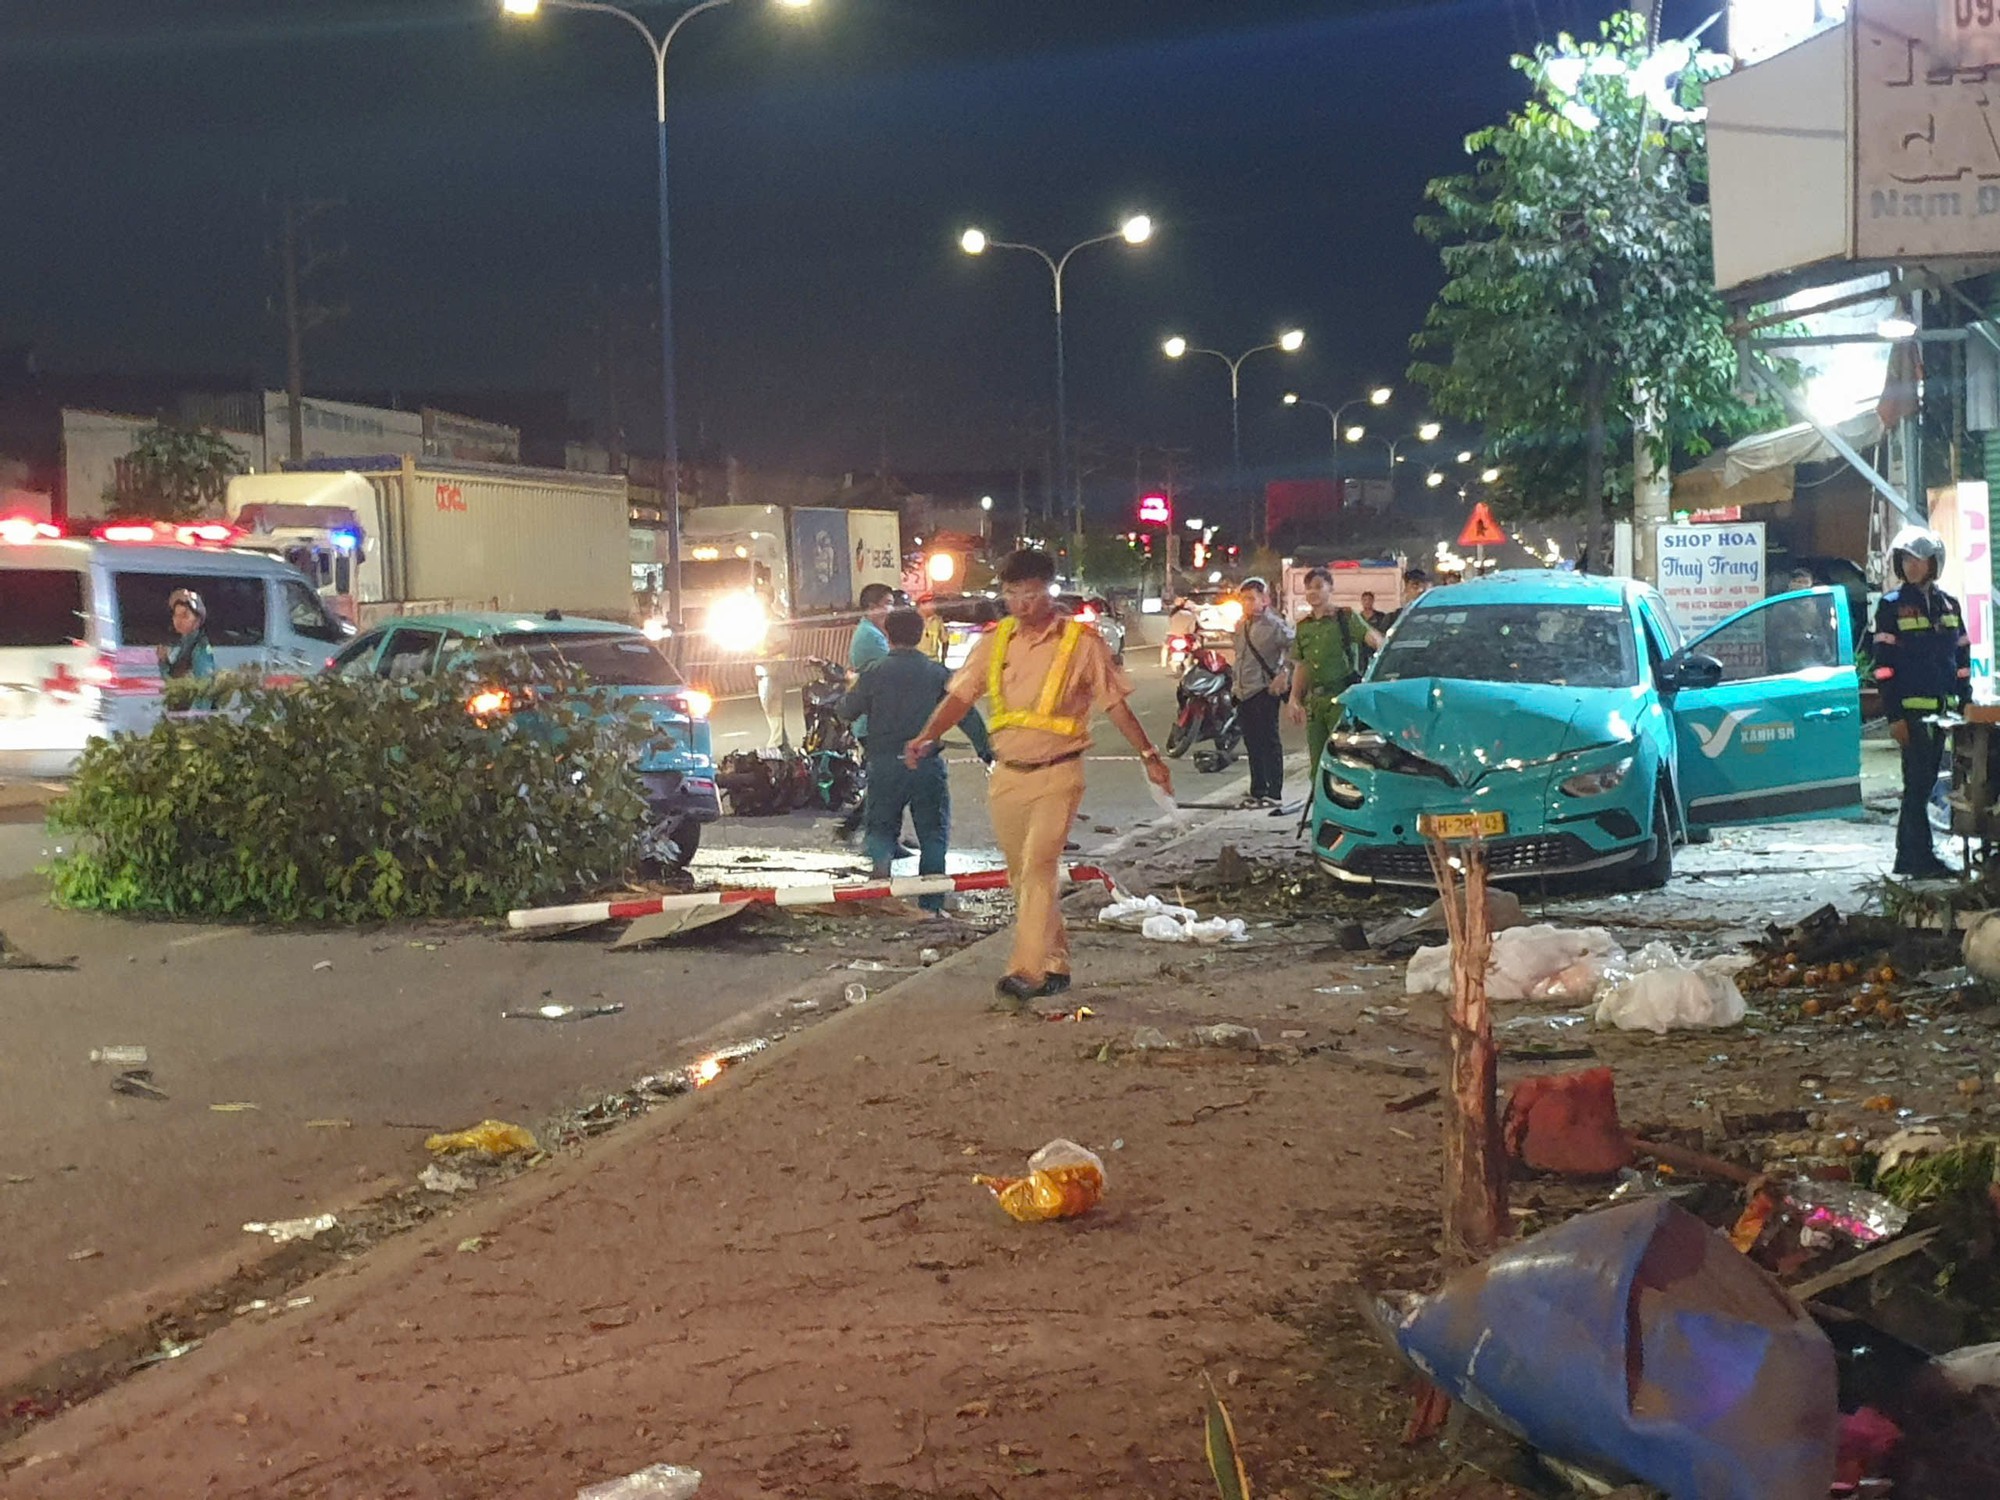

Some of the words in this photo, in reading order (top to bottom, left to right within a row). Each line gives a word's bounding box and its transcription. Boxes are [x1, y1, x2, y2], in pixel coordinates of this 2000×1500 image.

[1664, 534, 1712, 548] SHOP
[1718, 533, 1757, 546] HOA
[1708, 555, 1758, 582] Trang
